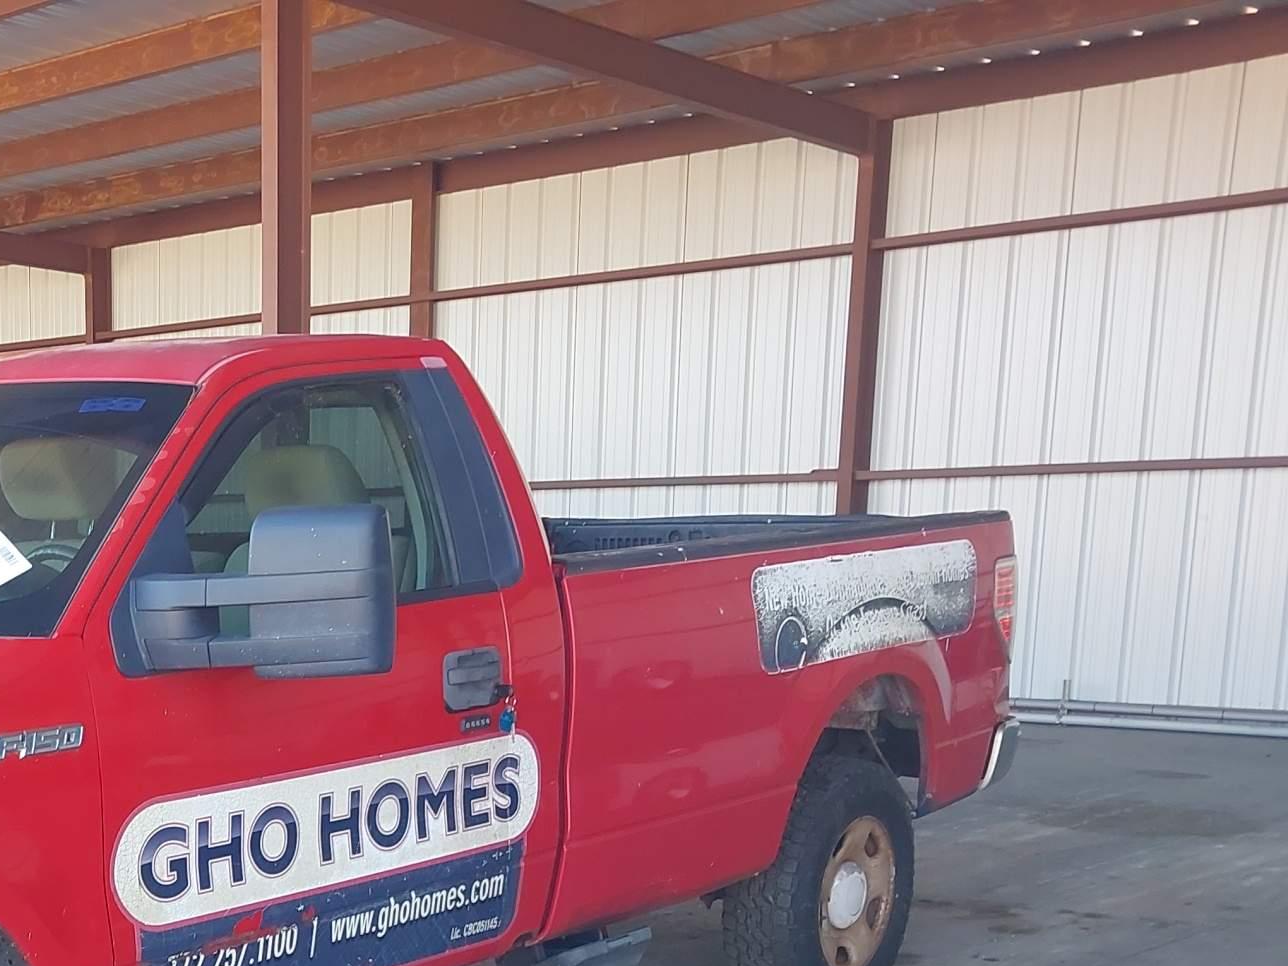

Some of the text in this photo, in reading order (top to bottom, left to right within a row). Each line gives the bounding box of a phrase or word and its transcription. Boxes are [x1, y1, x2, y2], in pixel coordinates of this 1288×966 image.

[138, 753, 522, 902] GHO HOMES
[330, 873, 505, 943] www.ghohomes.com
